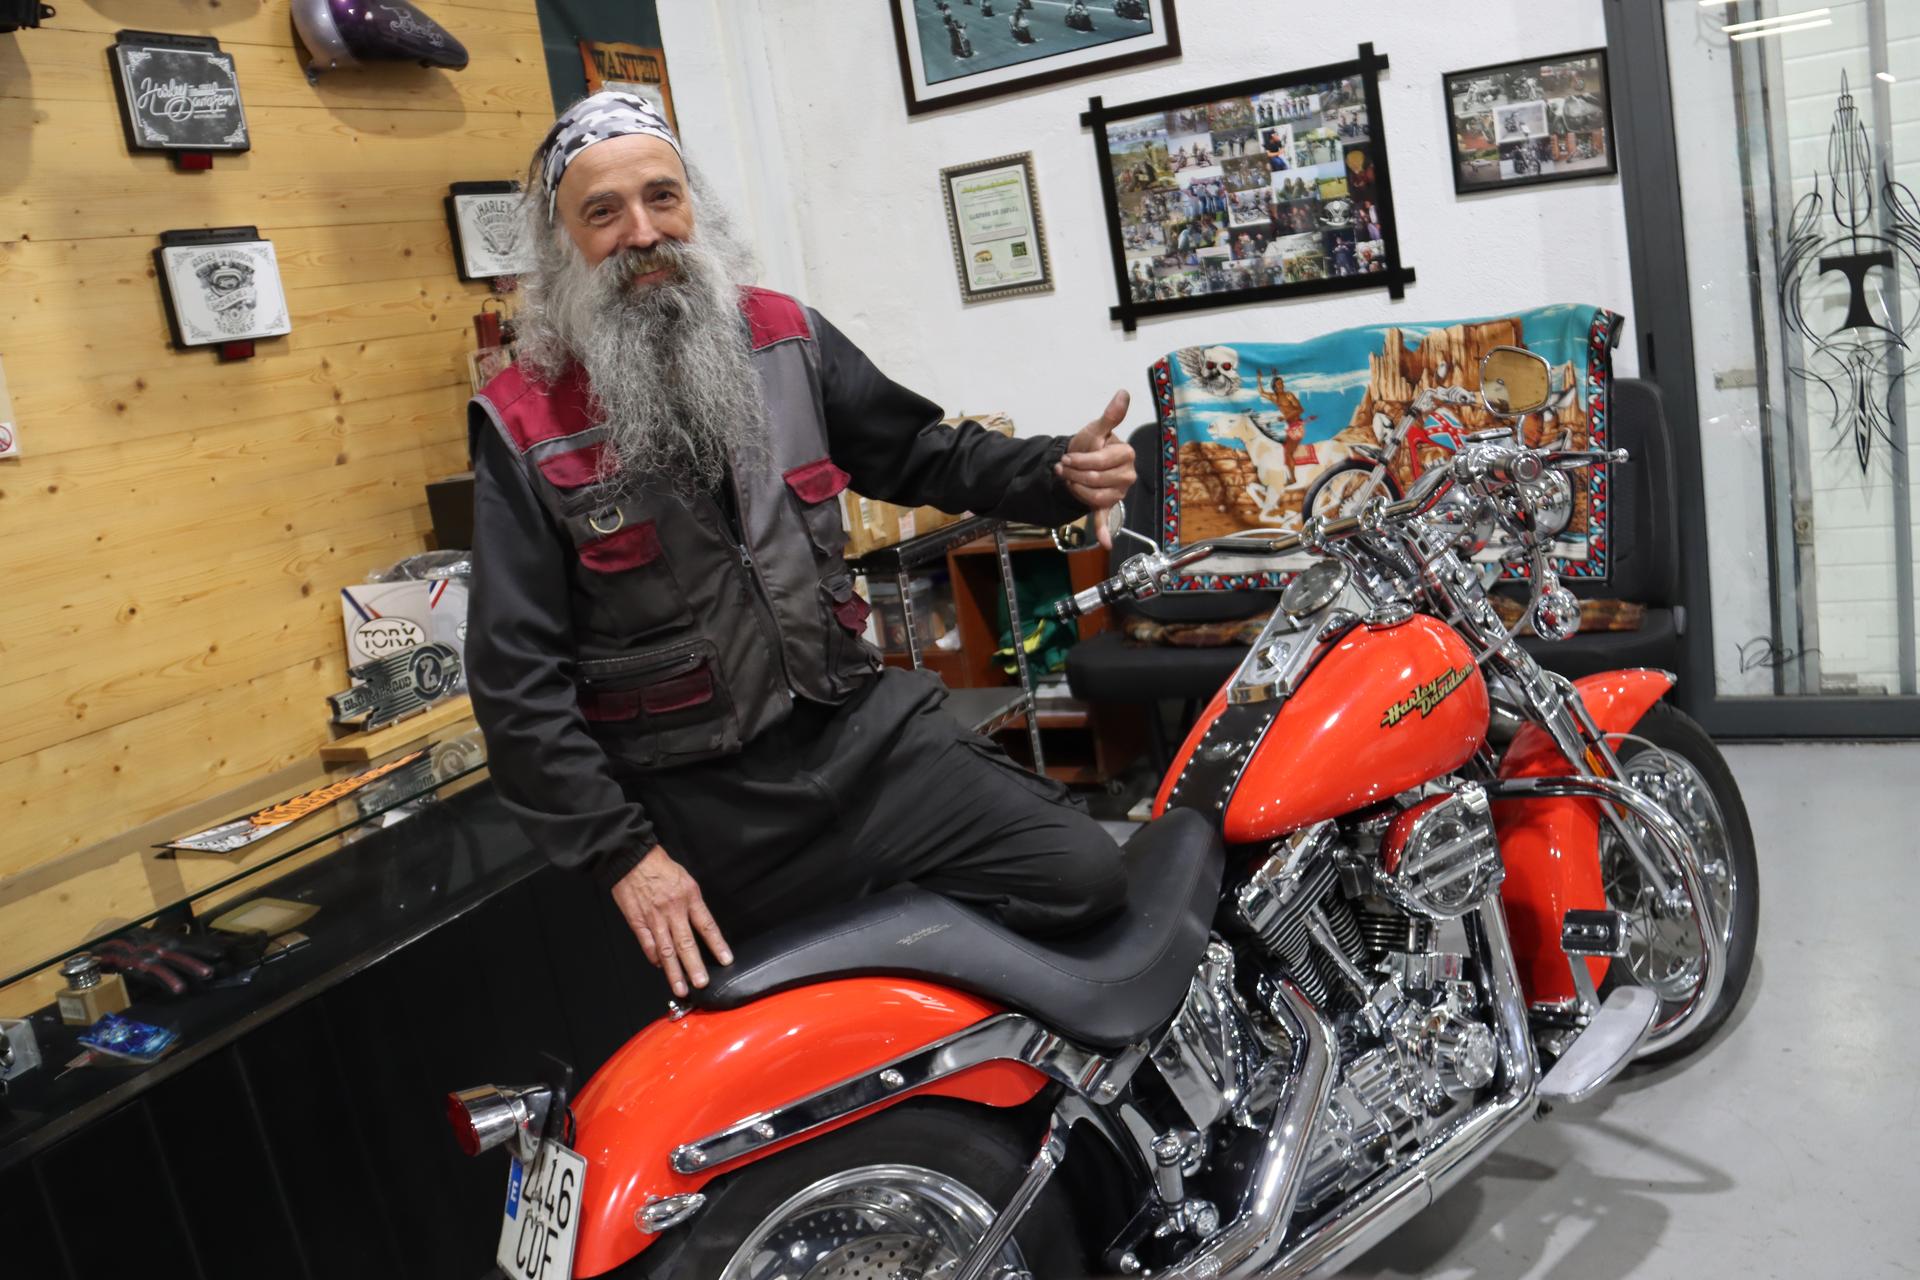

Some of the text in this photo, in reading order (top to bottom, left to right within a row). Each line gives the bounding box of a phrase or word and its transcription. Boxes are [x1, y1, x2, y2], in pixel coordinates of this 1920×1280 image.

[476, 200, 513, 219] HARLEY
[1416, 664, 1474, 720] Davidson
[510, 1180, 519, 1202] E
